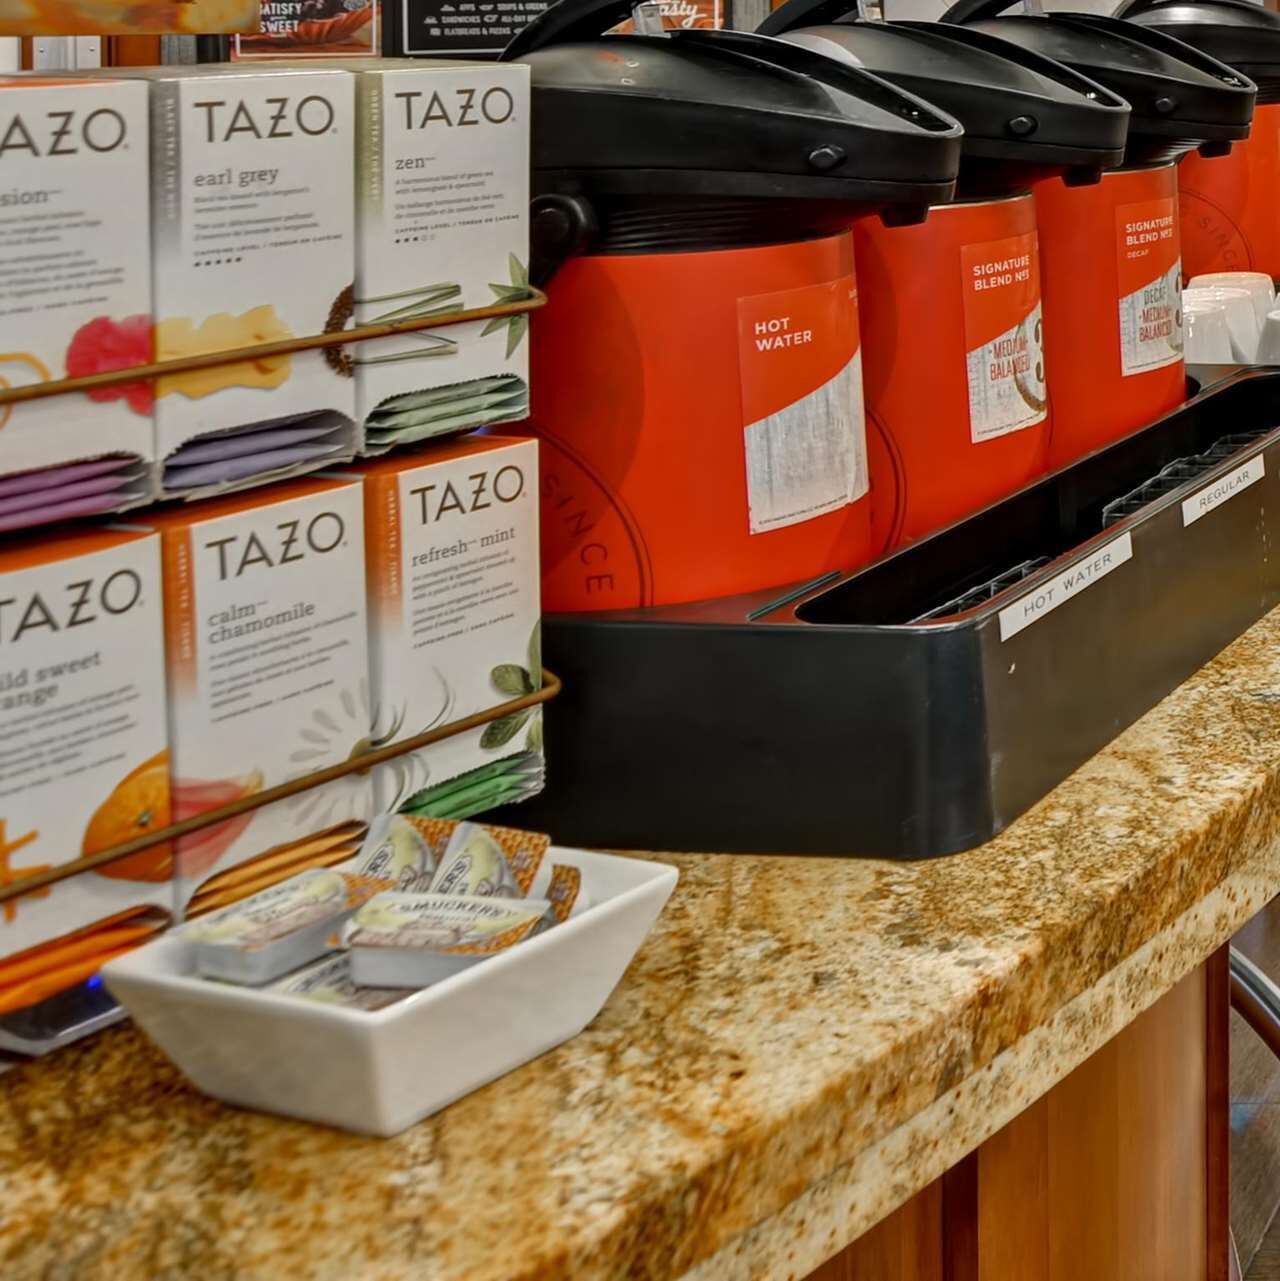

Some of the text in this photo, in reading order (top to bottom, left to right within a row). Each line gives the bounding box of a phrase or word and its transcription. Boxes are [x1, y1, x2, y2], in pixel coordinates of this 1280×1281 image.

[260, 21, 299, 33] SWEET
[660, 0, 707, 28] asty
[193, 95, 335, 144] TAZO
[394, 86, 515, 130] TAZO
[394, 157, 425, 170] zen
[194, 169, 279, 188] earl grey
[1125, 216, 1173, 233] SIGNATURE
[1126, 232, 1158, 246] BLEND
[973, 255, 1030, 277] SIGNATURE
[1127, 249, 1149, 259] DECAF
[974, 273, 1012, 291] BLEND
[755, 318, 790, 335] HOT
[755, 331, 812, 352] WATER
[410, 465, 526, 525] TAZO
[1199, 469, 1250, 509] REGULAR
[544, 473, 614, 594] SINCE
[205, 512, 346, 582] TAZO
[411, 527, 515, 568] refresh mint
[1023, 552, 1113, 619] HOT WATER
[208, 604, 257, 628] calm
[208, 601, 315, 645] chamomile
[35, 651, 101, 682] sweet
